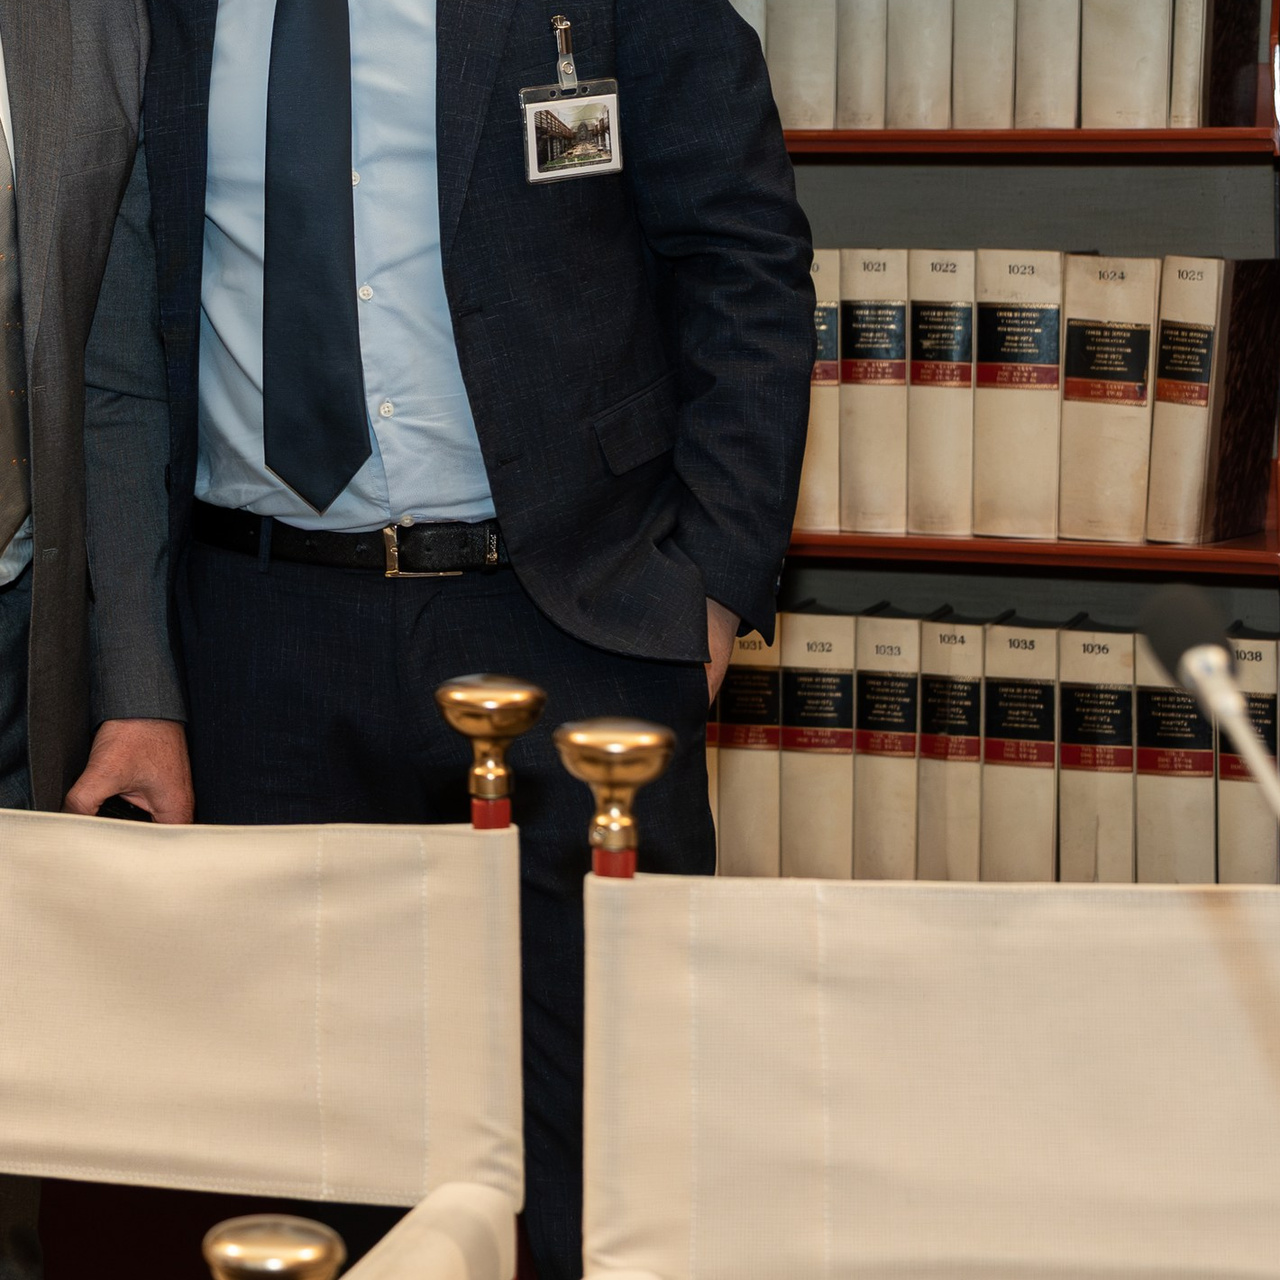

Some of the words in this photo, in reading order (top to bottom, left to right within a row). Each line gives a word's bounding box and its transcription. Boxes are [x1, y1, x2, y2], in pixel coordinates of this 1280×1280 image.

[862, 260, 887, 273] 1021
[930, 261, 957, 274] 1022
[1008, 264, 1035, 276] 1023
[1098, 270, 1126, 281] 1024
[1177, 268, 1204, 281] 1025
[738, 639, 763, 652] 1031
[939, 633, 966, 645] 1034
[1008, 638, 1036, 651] 1035
[806, 640, 833, 653] 1032
[874, 644, 902, 656] 1033
[1082, 642, 1110, 655] 1036
[1235, 649, 1263, 663] 1038
